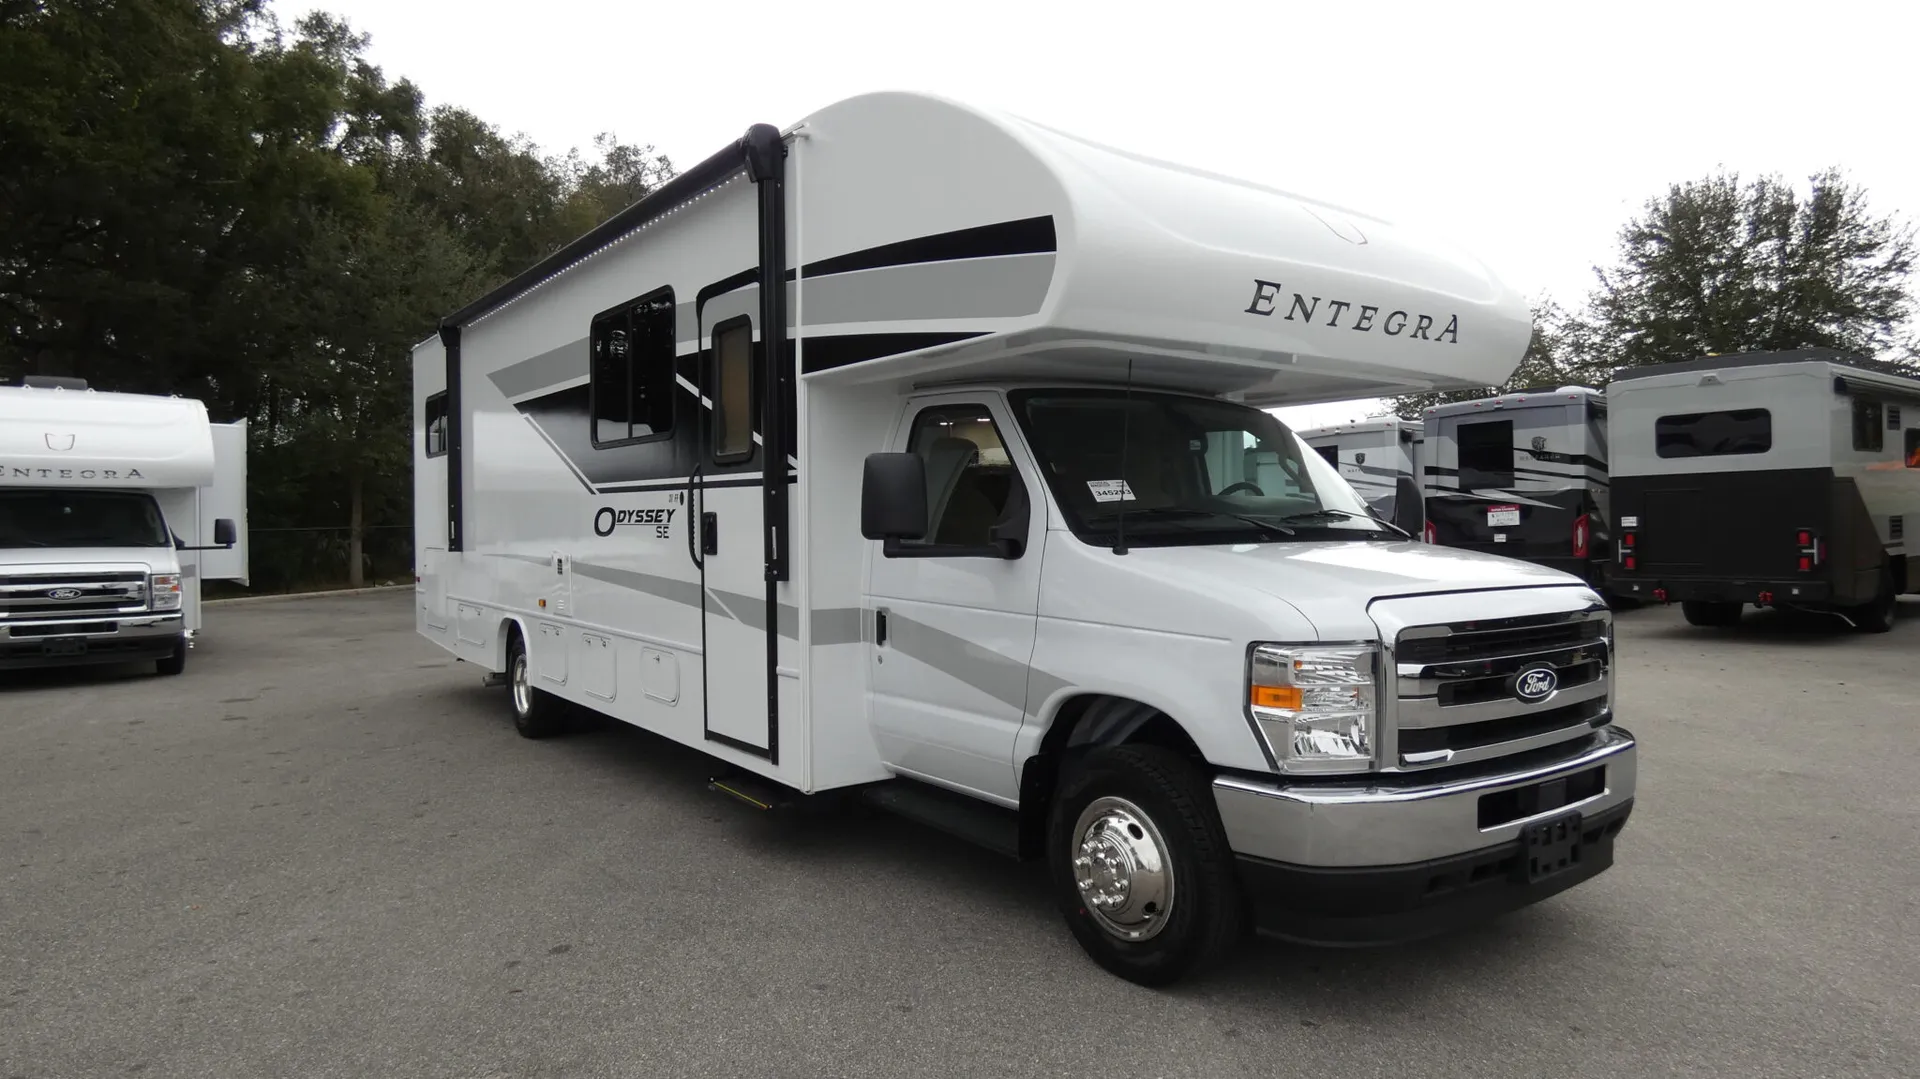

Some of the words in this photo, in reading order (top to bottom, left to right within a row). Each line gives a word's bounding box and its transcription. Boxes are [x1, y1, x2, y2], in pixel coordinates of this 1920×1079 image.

[1244, 278, 1459, 344] ENTEGRA
[594, 506, 676, 537] ODYSSEY
[656, 526, 670, 539] SE
[1524, 672, 1551, 694] Ford
